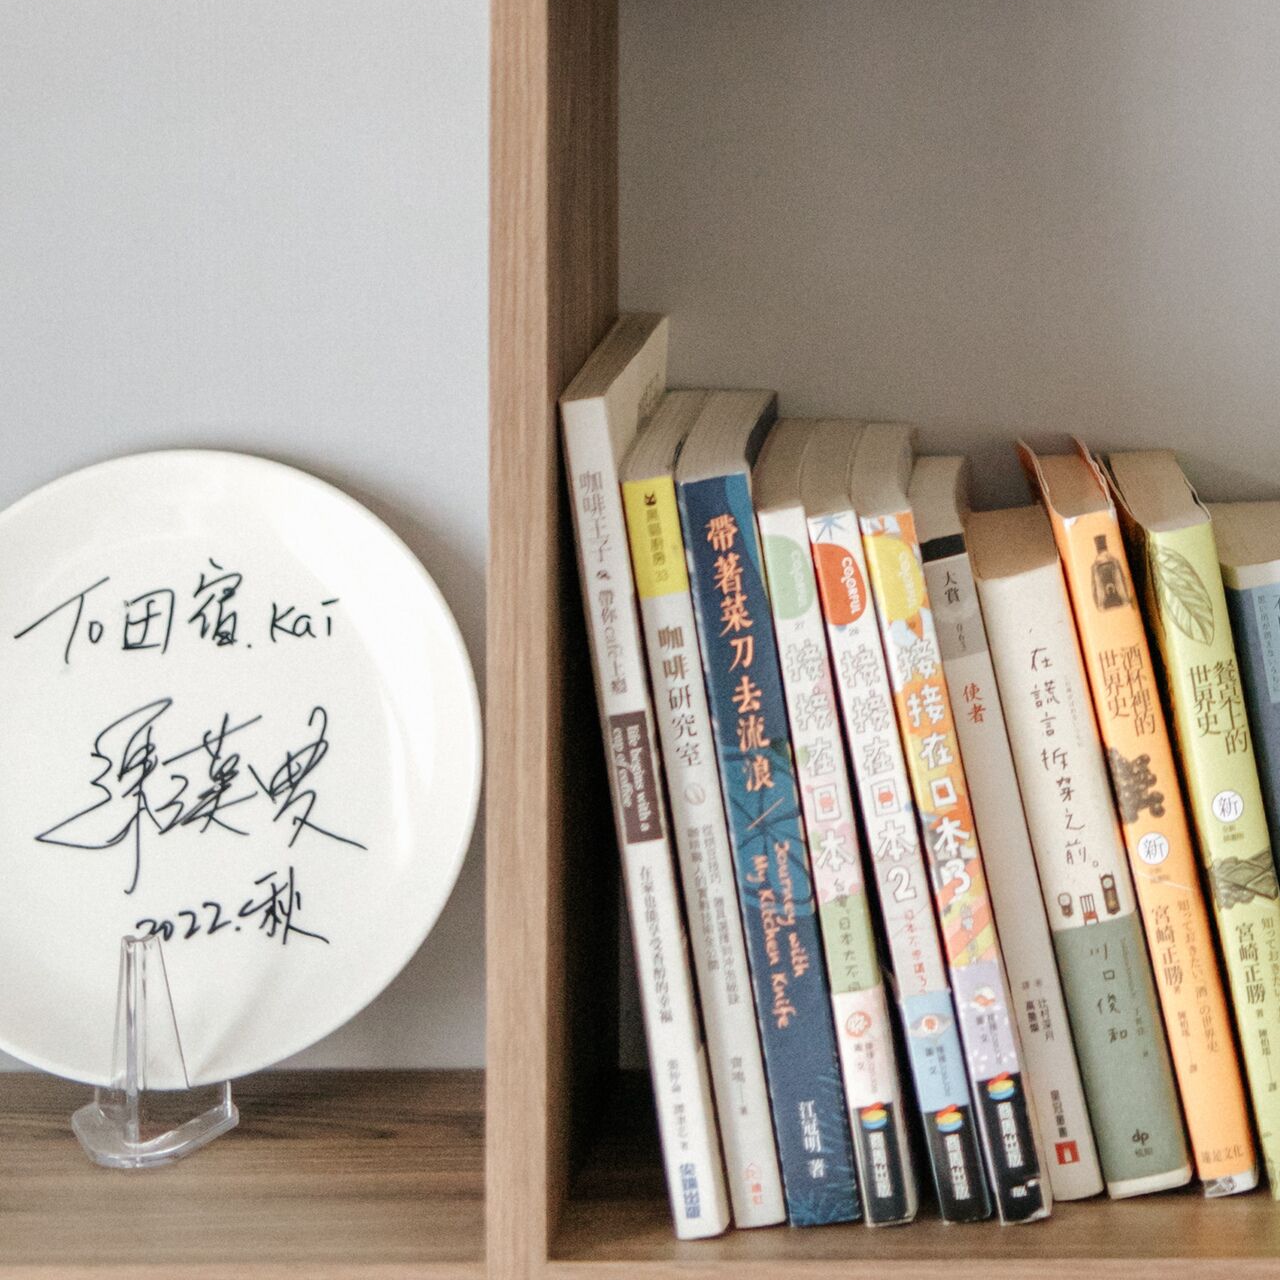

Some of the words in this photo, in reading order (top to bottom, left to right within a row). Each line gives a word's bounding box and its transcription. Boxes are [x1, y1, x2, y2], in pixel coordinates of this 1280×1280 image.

[706, 514, 776, 793] 帶著菜刀去流浪
[1098, 649, 1131, 722] 世界史
[1119, 642, 1157, 737] 酒杯裡的
[658, 624, 701, 768] 咖啡研究室
[962, 681, 987, 724] 使者
[1188, 665, 1222, 738] 世界史
[1212, 659, 1249, 756] 餐桌上的
[1217, 795, 1240, 819] 新
[752, 854, 769, 886] My
[1143, 837, 1164, 860] 新
[757, 889, 784, 969] Kitchen
[773, 840, 795, 927] Journey
[787, 930, 806, 978] with
[1151, 904, 1184, 986] 宮崎正勝
[1235, 922, 1266, 1004] 宮崎正勝
[771, 972, 798, 1031] Knife
[798, 1100, 822, 1154] 江冠明
[1131, 1128, 1150, 1146] dp
